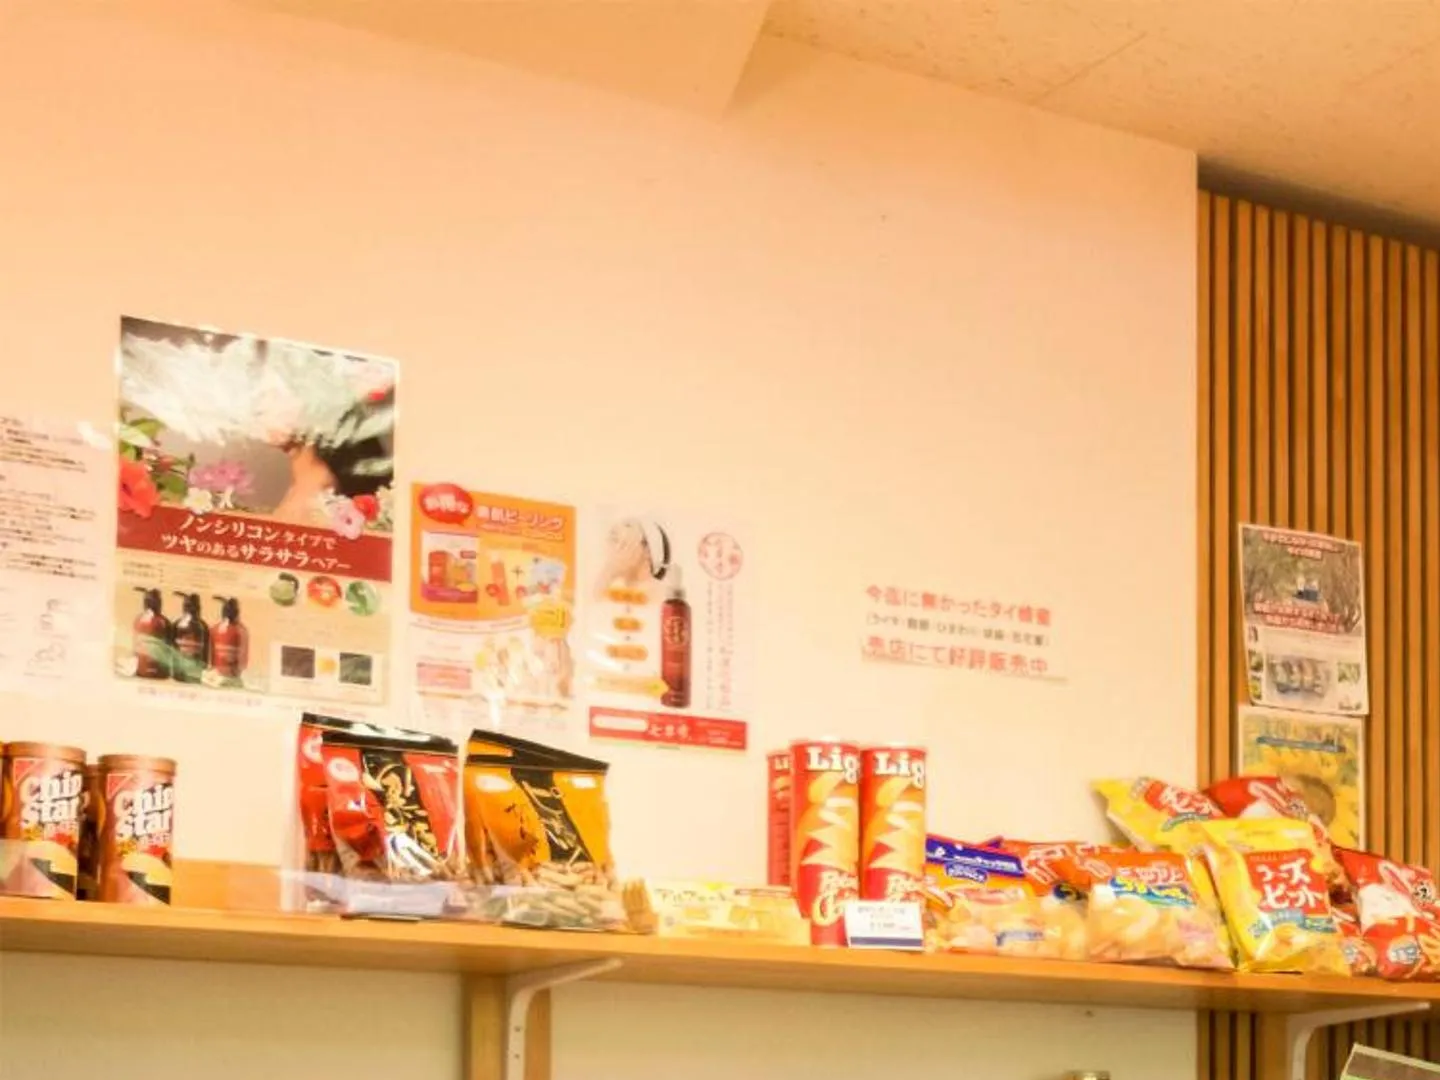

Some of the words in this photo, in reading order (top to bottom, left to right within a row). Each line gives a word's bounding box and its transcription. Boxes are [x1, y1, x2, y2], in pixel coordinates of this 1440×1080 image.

[179, 515, 336, 550] ノンシリコンタイプで
[161, 533, 351, 571] ツヤのあるサラサラヘアー
